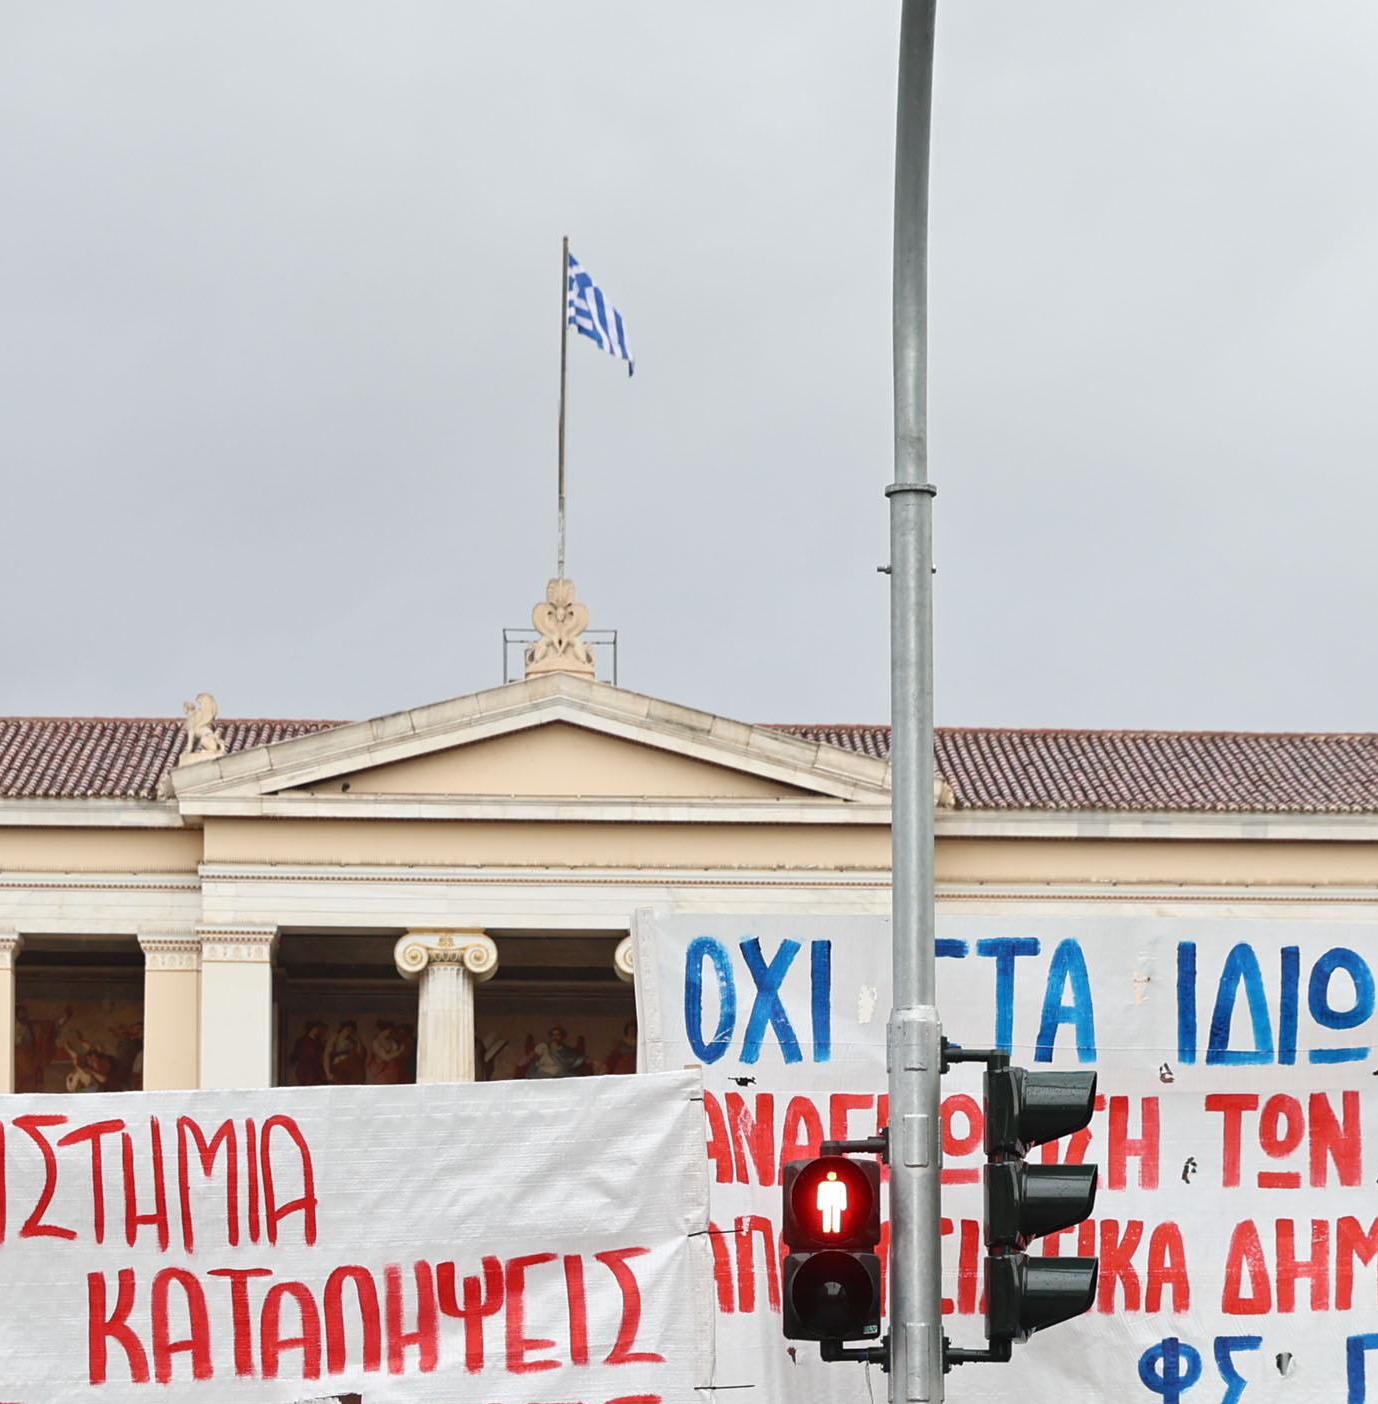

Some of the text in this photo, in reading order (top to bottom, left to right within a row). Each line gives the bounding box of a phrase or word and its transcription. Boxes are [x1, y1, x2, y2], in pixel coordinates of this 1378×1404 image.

[686, 937, 832, 1065] ΟΧΙ
[936, 938, 1098, 1065] ΤΑ
[1206, 1091, 1363, 1190] ΤΩΝ
[89, 1248, 666, 1386] ΚΑΤΑΛΗΨΕΙΣ
